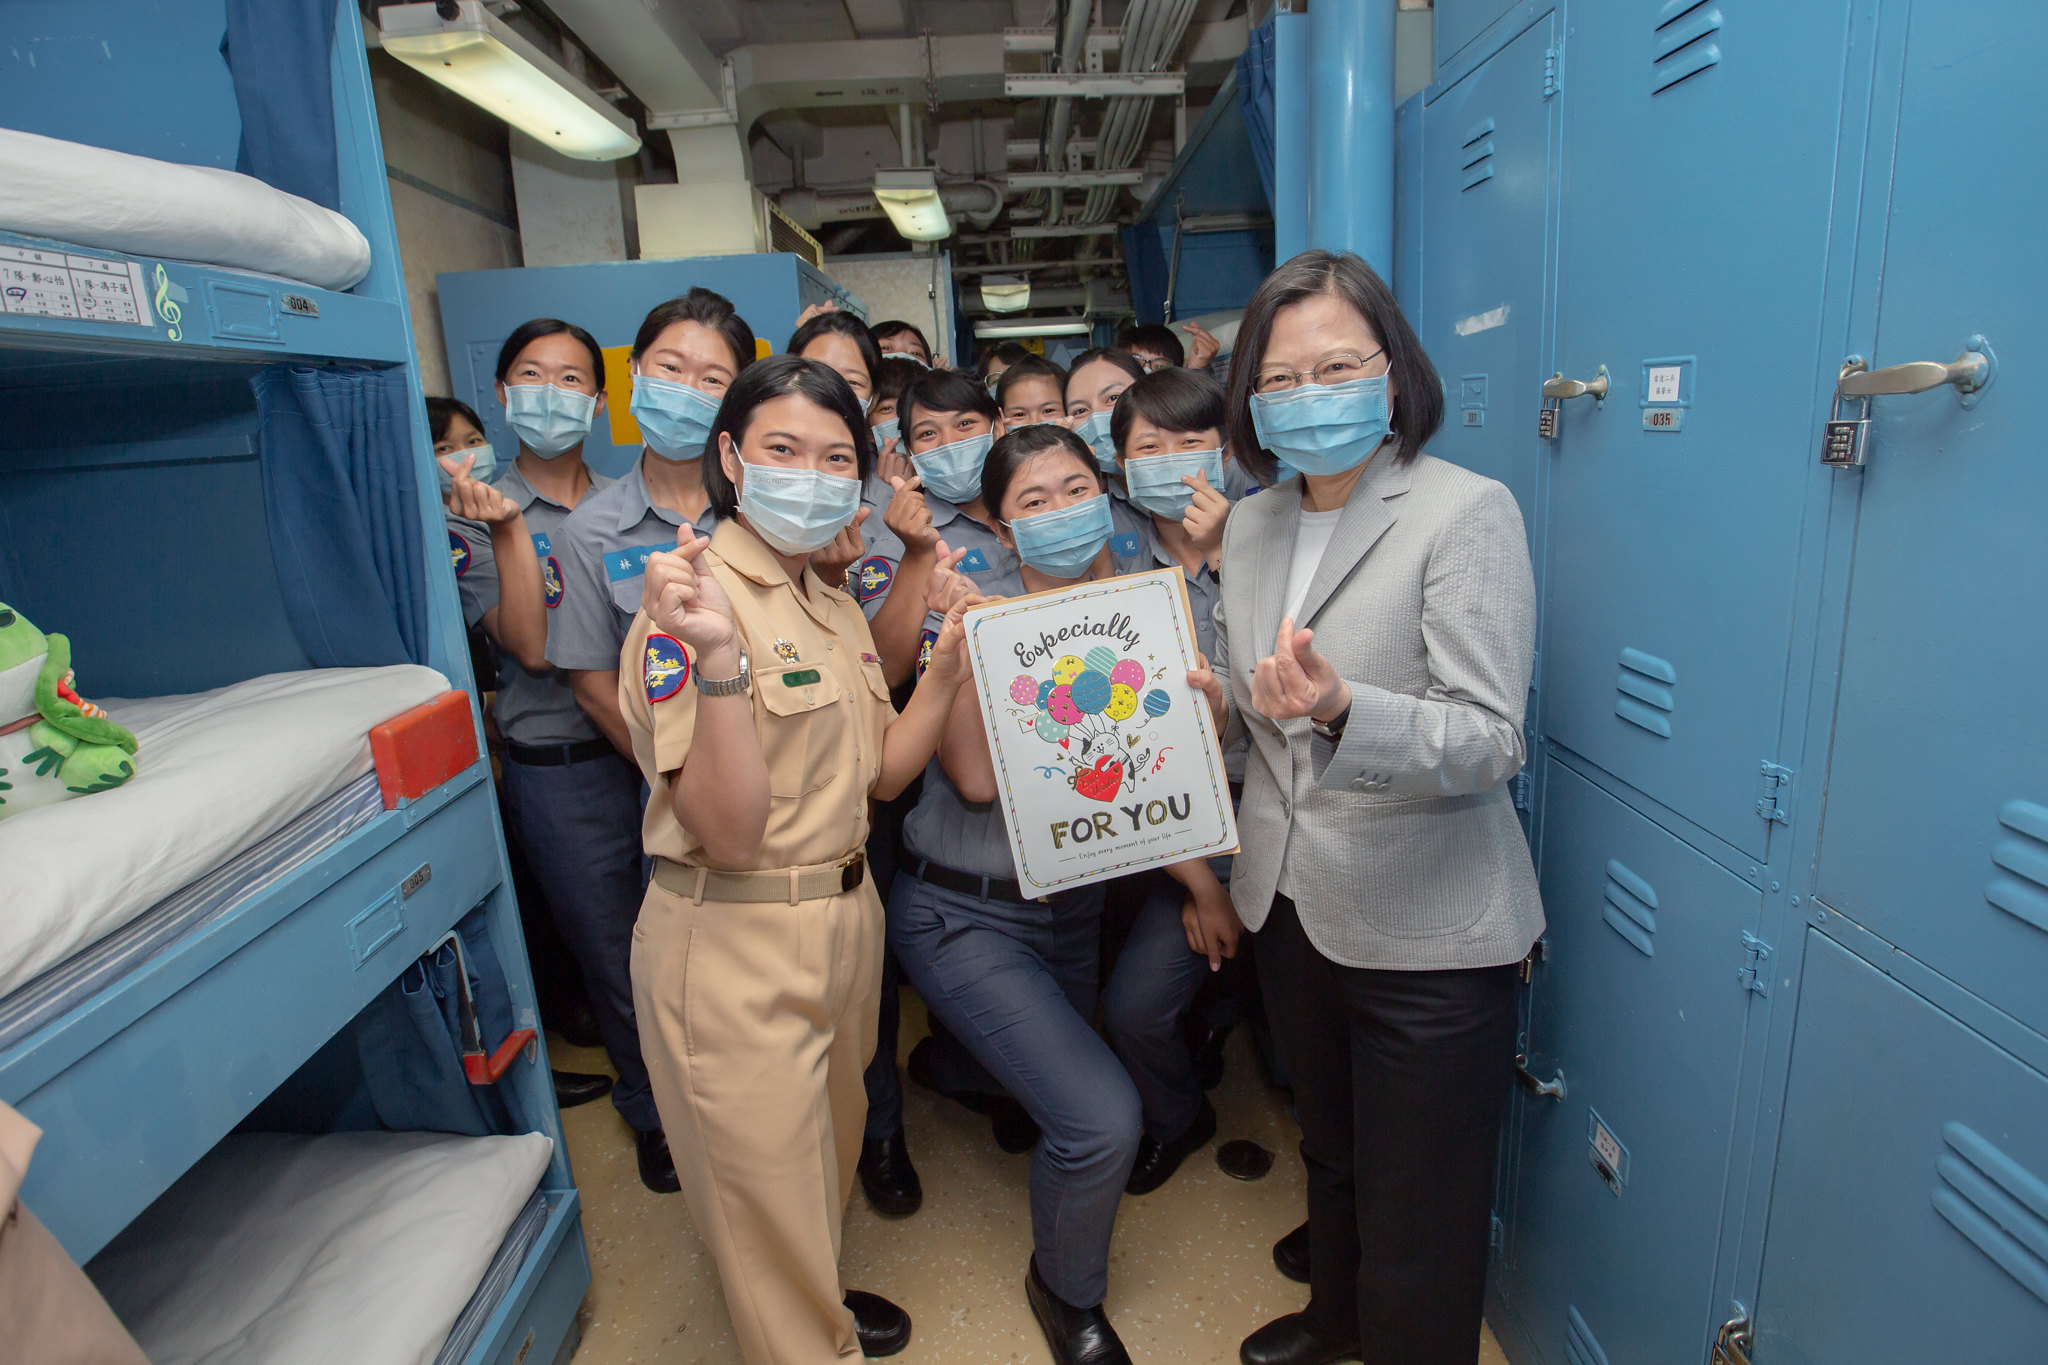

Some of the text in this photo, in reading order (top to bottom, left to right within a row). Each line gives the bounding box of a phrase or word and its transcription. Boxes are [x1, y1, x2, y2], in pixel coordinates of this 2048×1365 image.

[290, 296, 308, 311] 004
[1653, 413, 1671, 426] 035
[1013, 612, 1140, 668] Especially
[1050, 793, 1191, 849] FOR YOU
[1079, 851, 1096, 860] Enjoy
[1098, 847, 1113, 855] every
[1115, 841, 1139, 850] moment
[1140, 838, 1146, 846] of
[1148, 836, 1160, 844] your
[409, 871, 424, 889] 005
